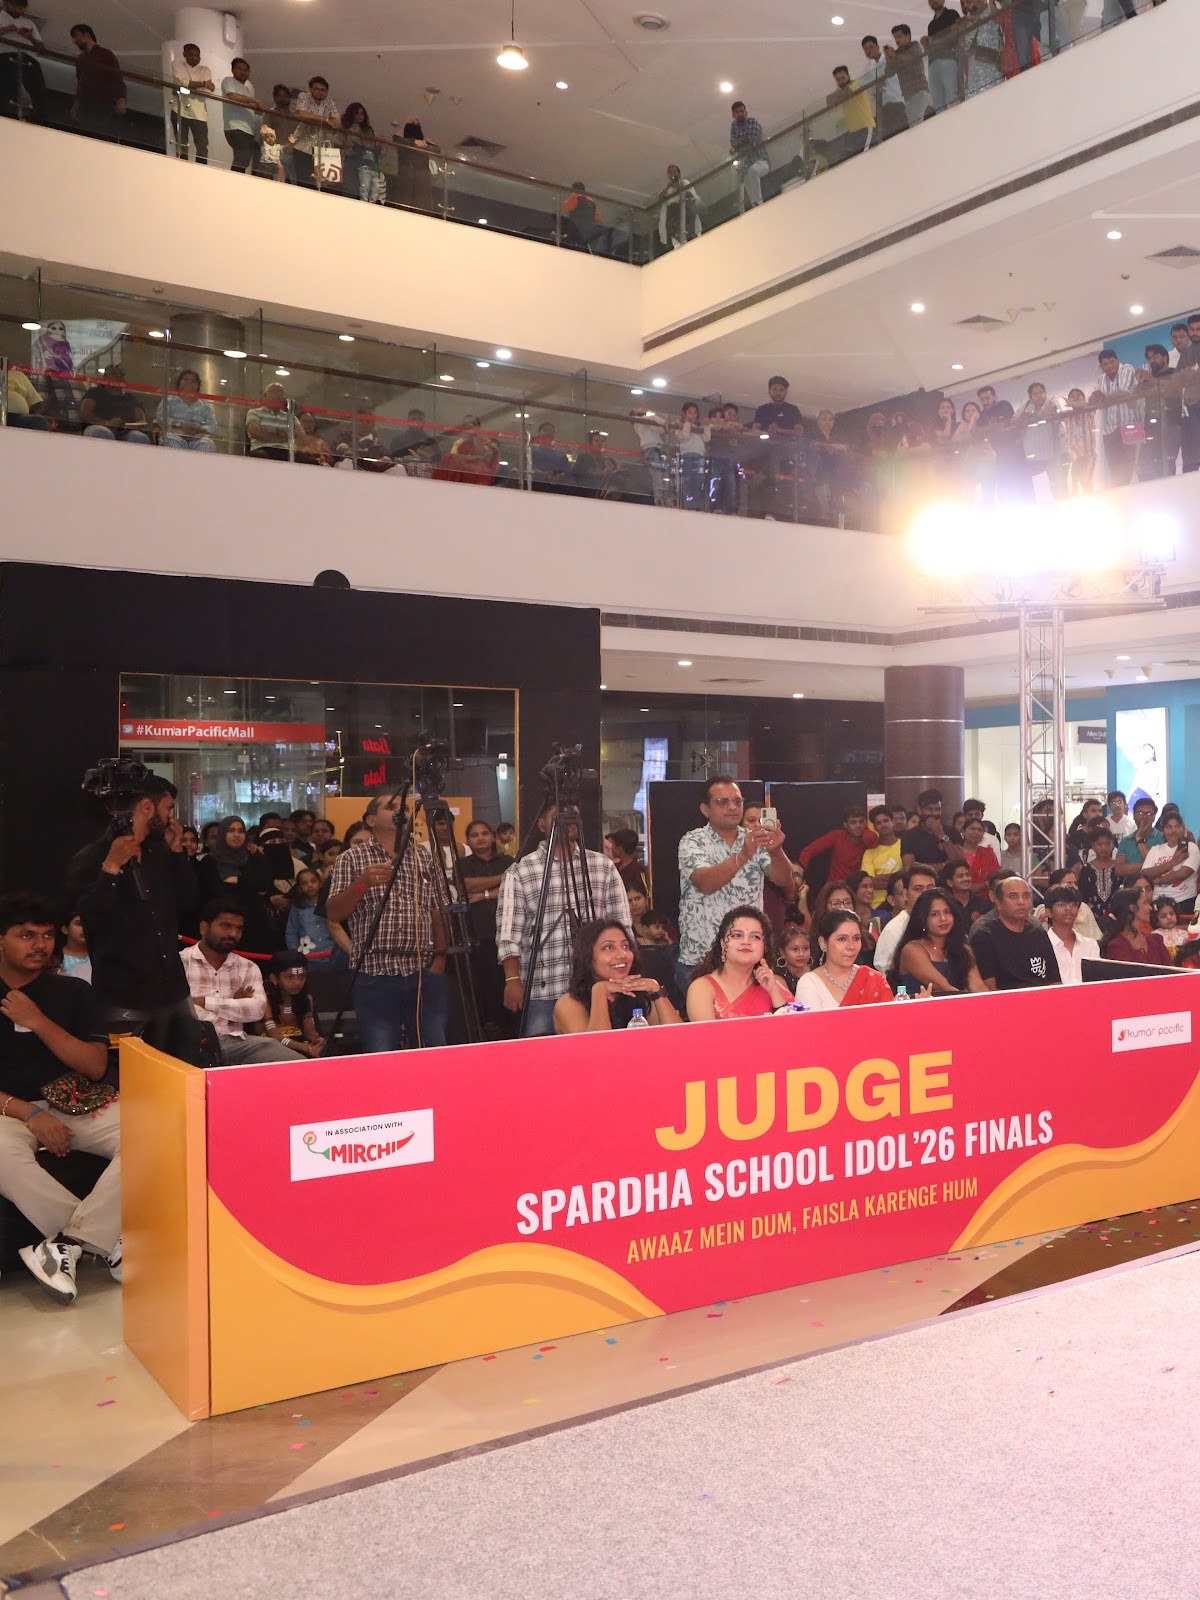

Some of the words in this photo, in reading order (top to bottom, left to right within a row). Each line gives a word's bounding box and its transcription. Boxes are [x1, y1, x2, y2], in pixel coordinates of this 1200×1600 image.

[136, 724, 254, 739] #KumarPacificMall
[1127, 1028, 1156, 1038] kumar
[1158, 1023, 1185, 1037] pacific
[654, 1050, 954, 1151] JUDGE
[334, 1124, 383, 1136] ASSOCIATION
[384, 1121, 403, 1129] WITH
[331, 1140, 396, 1164] MIRCHI
[516, 1168, 693, 1235] SPARDHA
[704, 1145, 834, 1202] SCHOOL
[965, 1110, 1053, 1157] FINALS
[626, 1229, 694, 1264] AWAAZ
[700, 1219, 745, 1250] MEIN
[751, 1210, 797, 1239] DUM,
[802, 1199, 859, 1229] FAISLA
[864, 1184, 938, 1218] KARENGE
[943, 1177, 978, 1202] HUM
